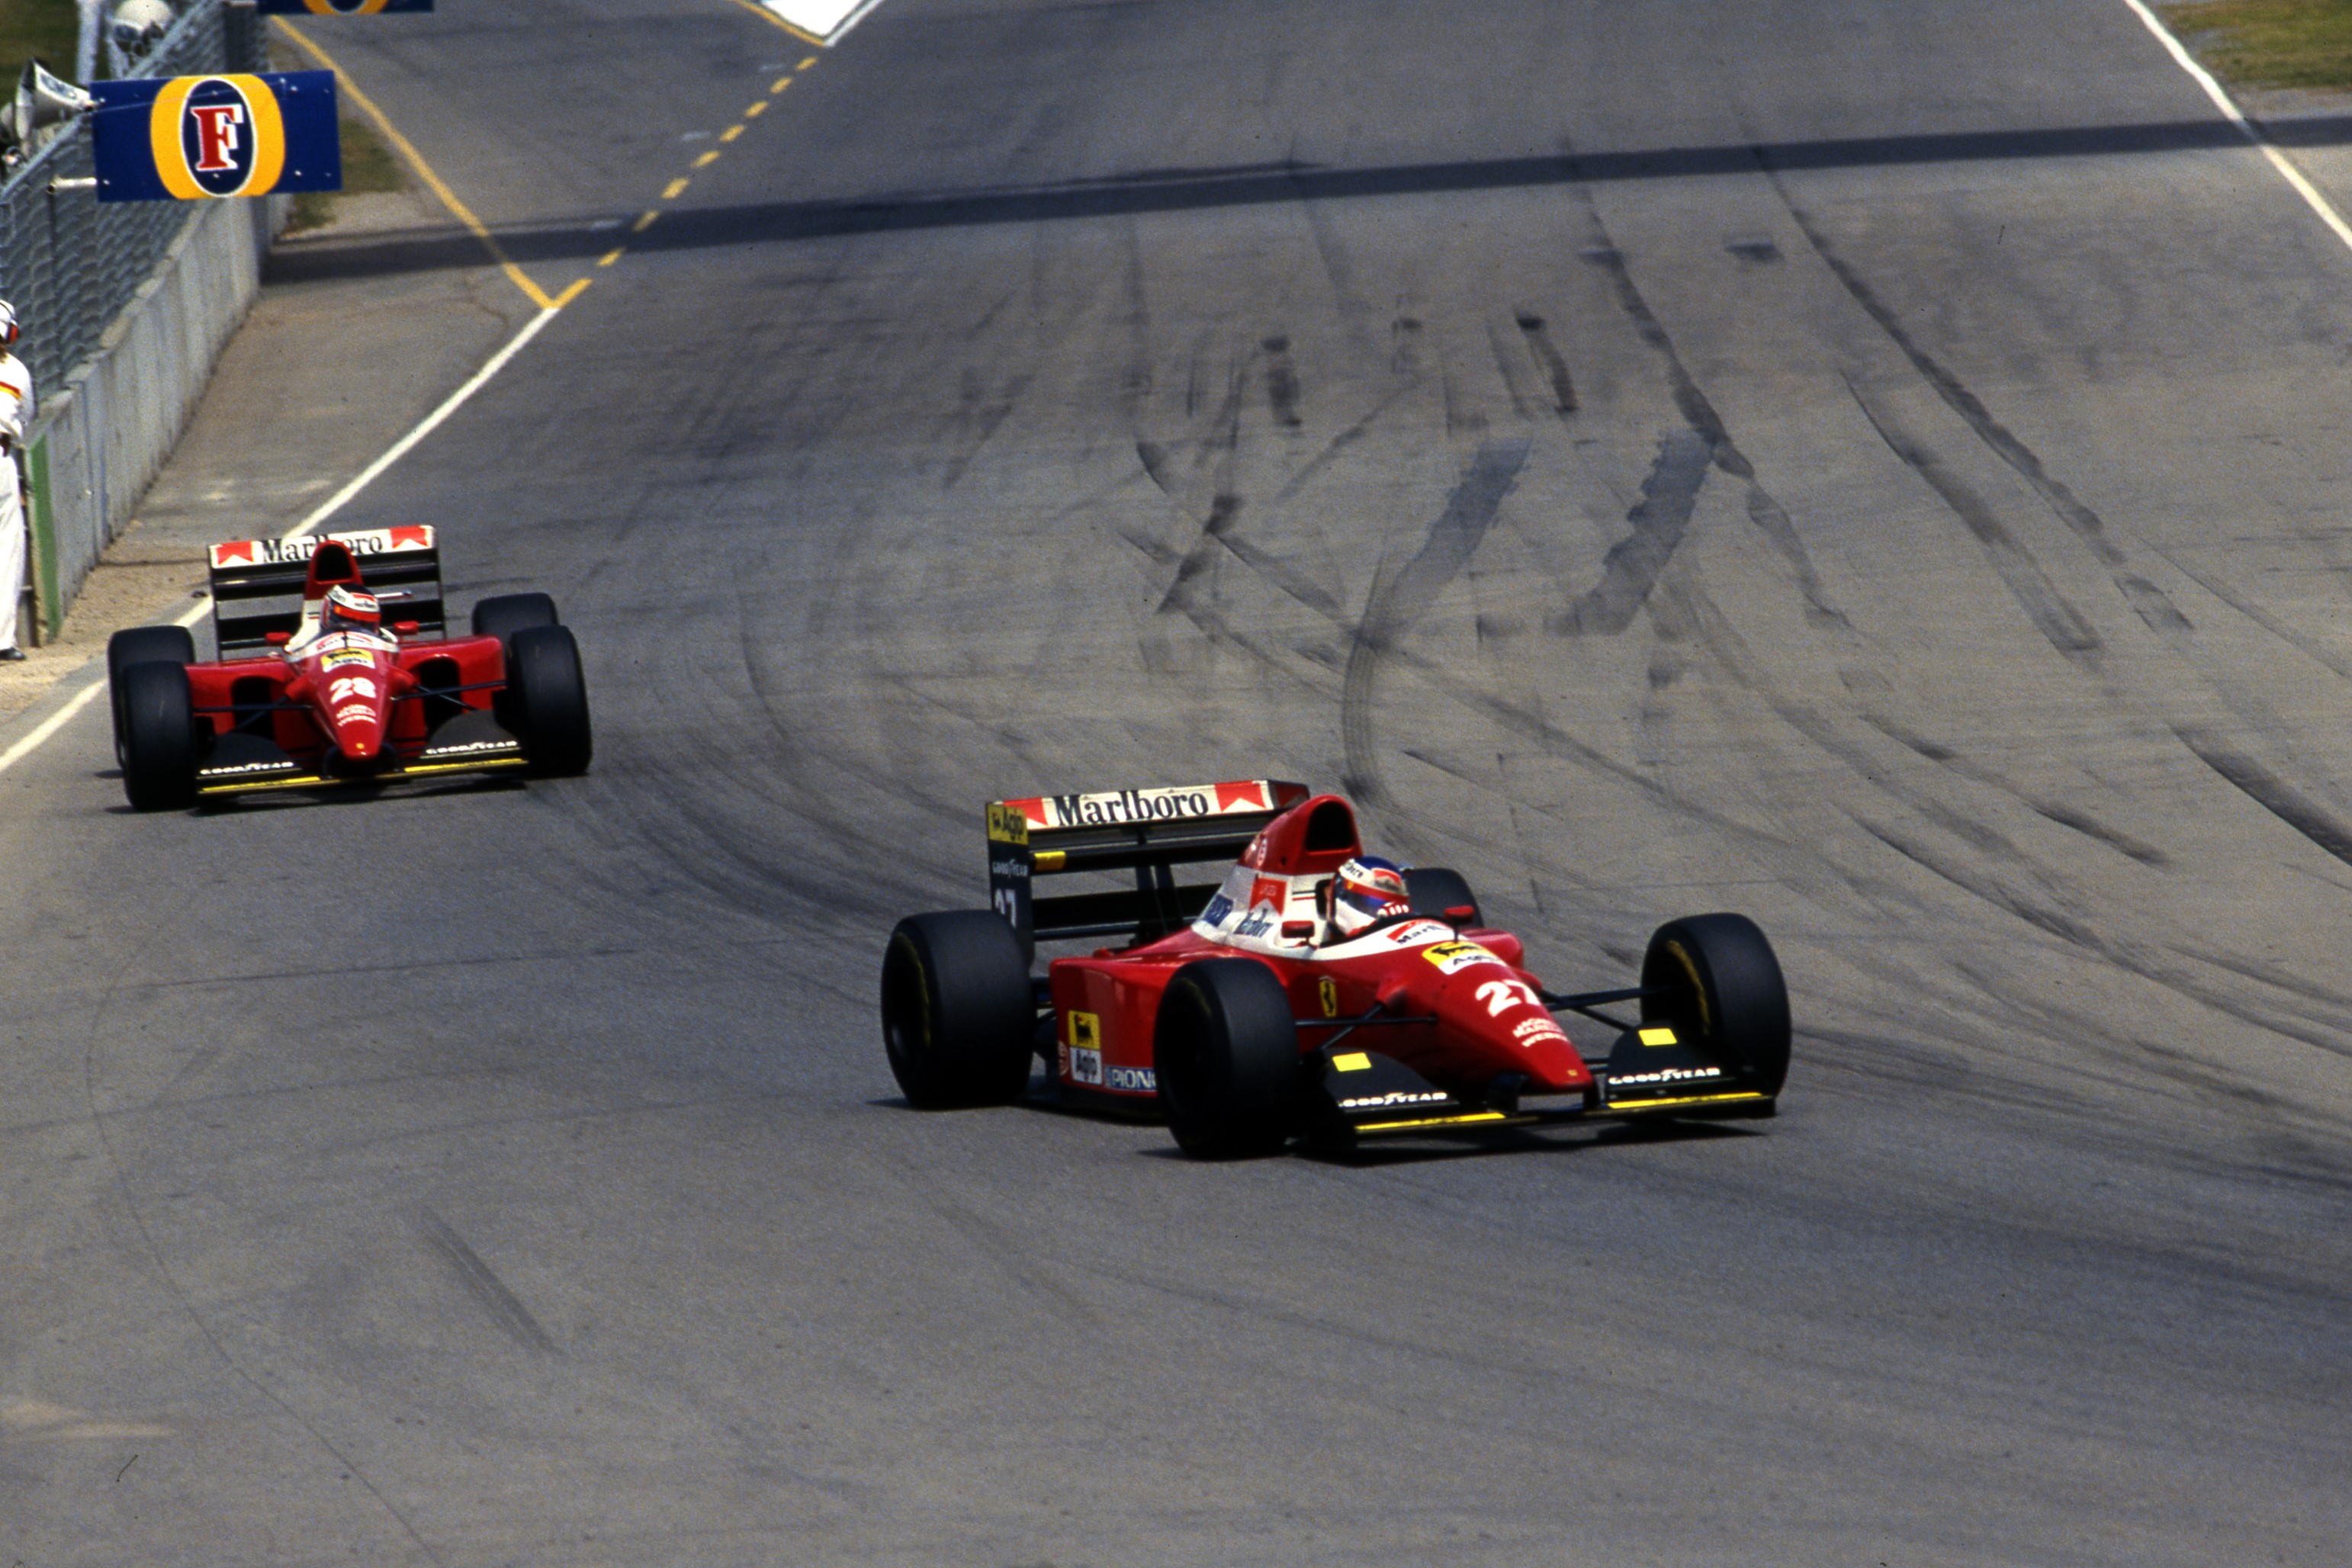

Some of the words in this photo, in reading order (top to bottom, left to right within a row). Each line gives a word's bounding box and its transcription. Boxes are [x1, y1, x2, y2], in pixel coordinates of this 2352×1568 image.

[262, 534, 384, 563] Maroro
[329, 676, 377, 705] 28
[1052, 789, 1210, 827] Marlboro
[1474, 978, 1541, 1017] 27
[1608, 1068, 1721, 1085] GOODYEAR
[1338, 1092, 1448, 1107] OODYEAR
